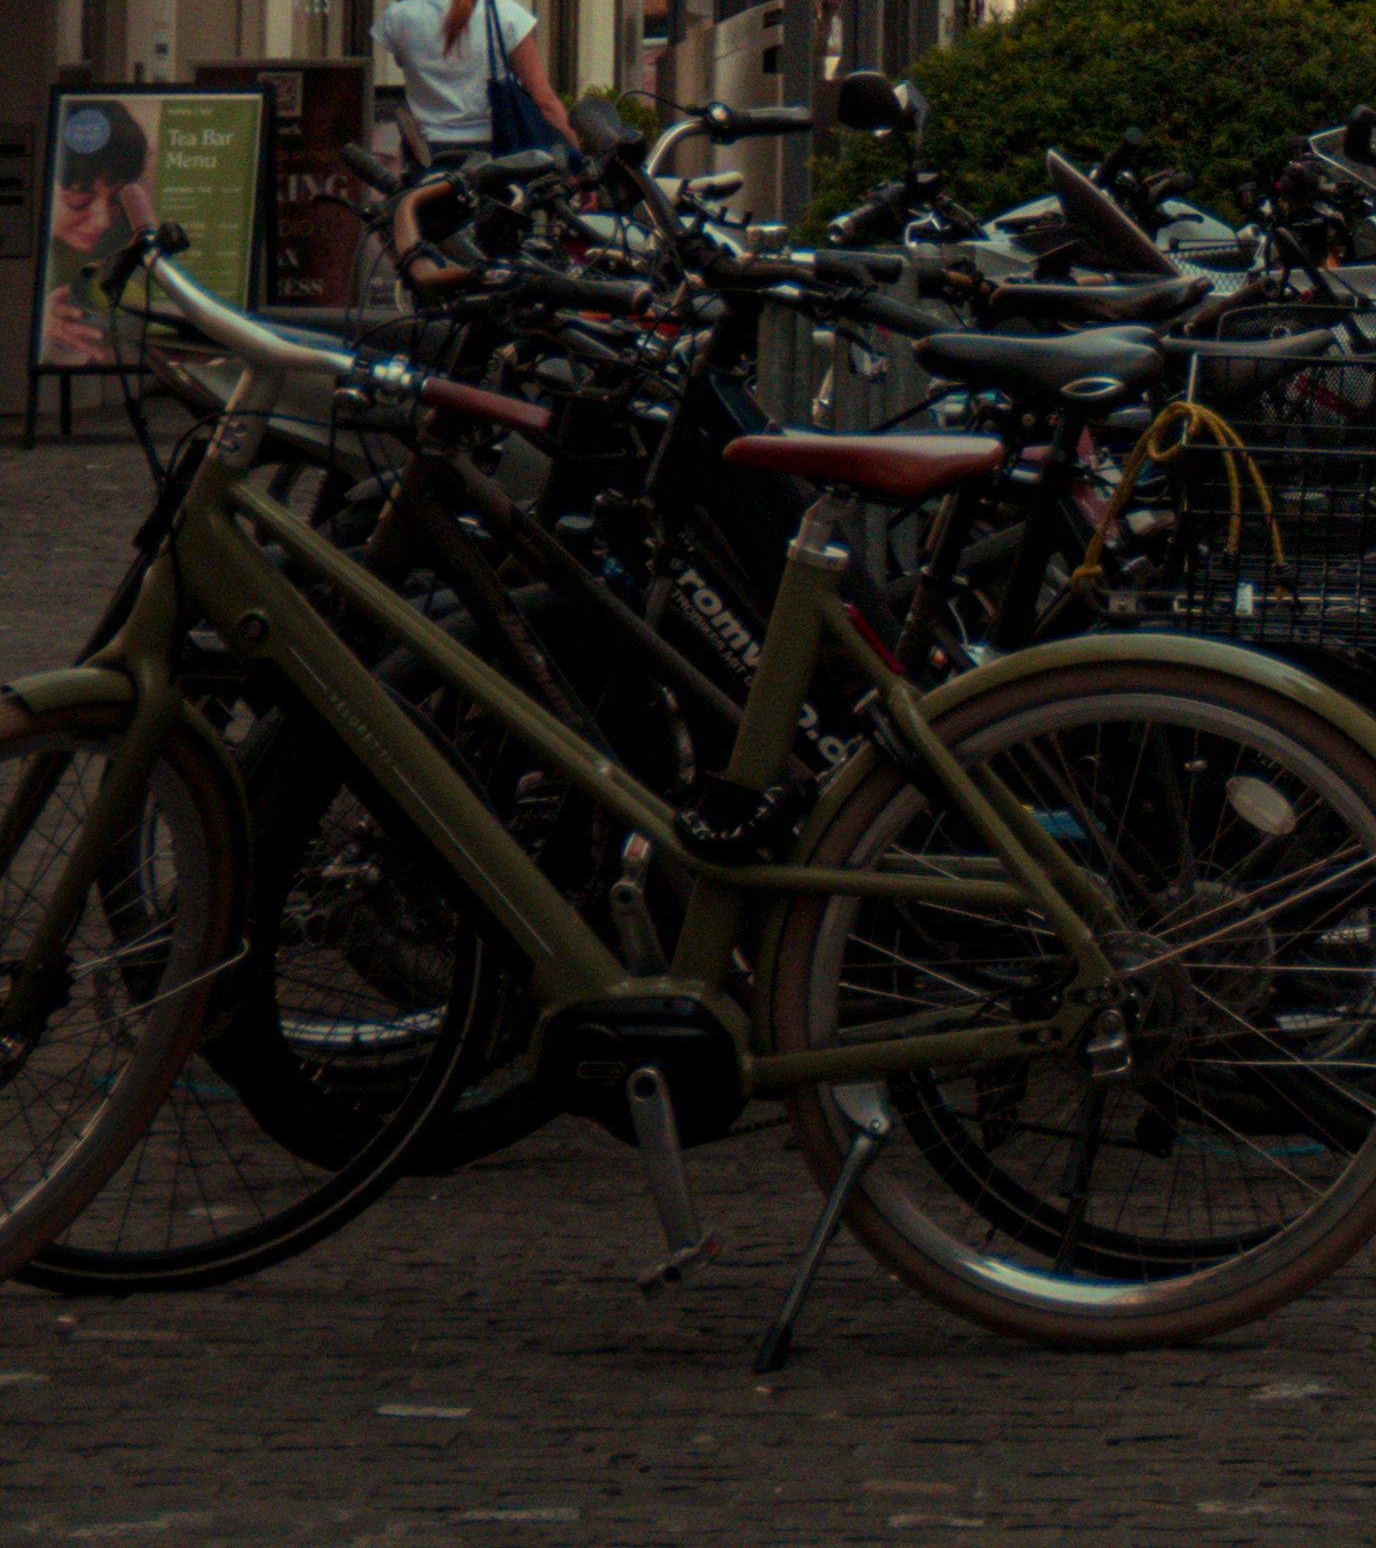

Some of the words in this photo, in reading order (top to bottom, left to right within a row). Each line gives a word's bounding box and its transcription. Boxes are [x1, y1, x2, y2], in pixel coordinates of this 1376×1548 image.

[168, 128, 198, 148] Tea
[202, 129, 235, 147] Bar
[166, 152, 217, 170] Menu
